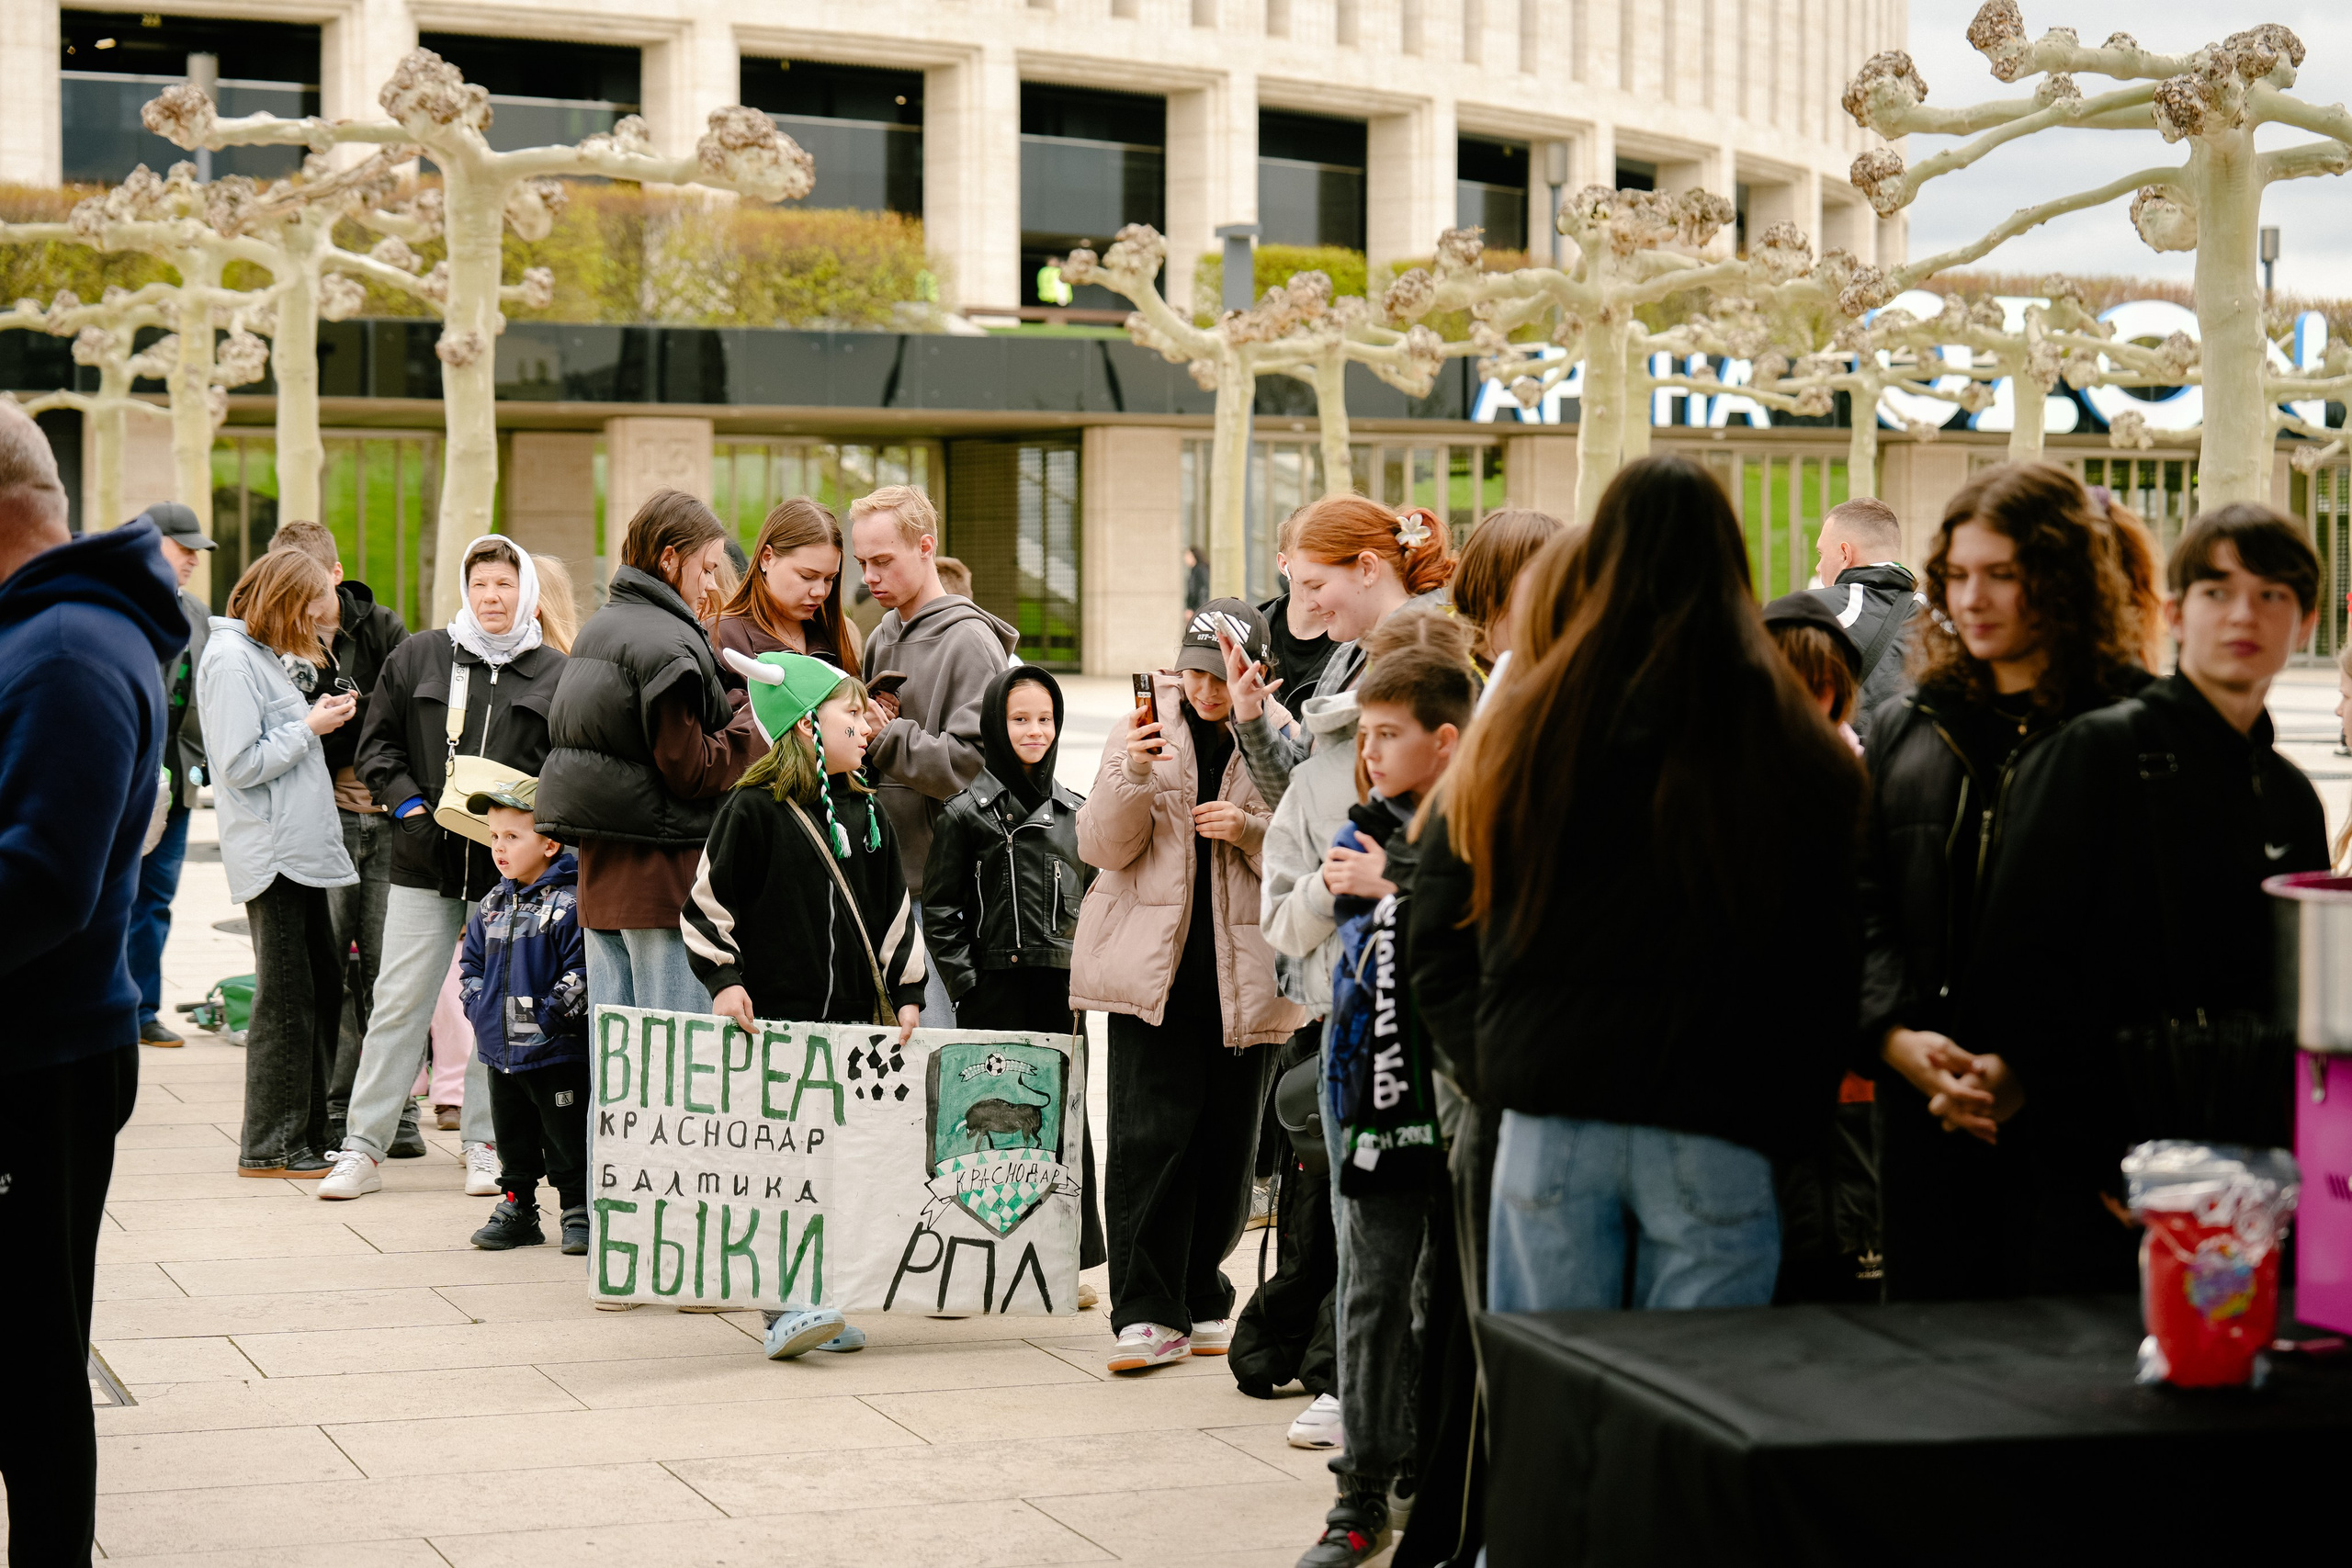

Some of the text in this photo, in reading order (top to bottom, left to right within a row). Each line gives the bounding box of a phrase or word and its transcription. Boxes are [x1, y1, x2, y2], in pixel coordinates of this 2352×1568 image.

[1471, 347, 1771, 429] АРНА
[598, 1011, 846, 1126] ВПЕРЁД
[599, 1111, 825, 1155] КРАСНОДАР
[956, 1162, 1061, 1191] КРАСНОДАР
[594, 1198, 824, 1306] БЫКИ
[883, 1222, 1054, 1314] РПЛ
